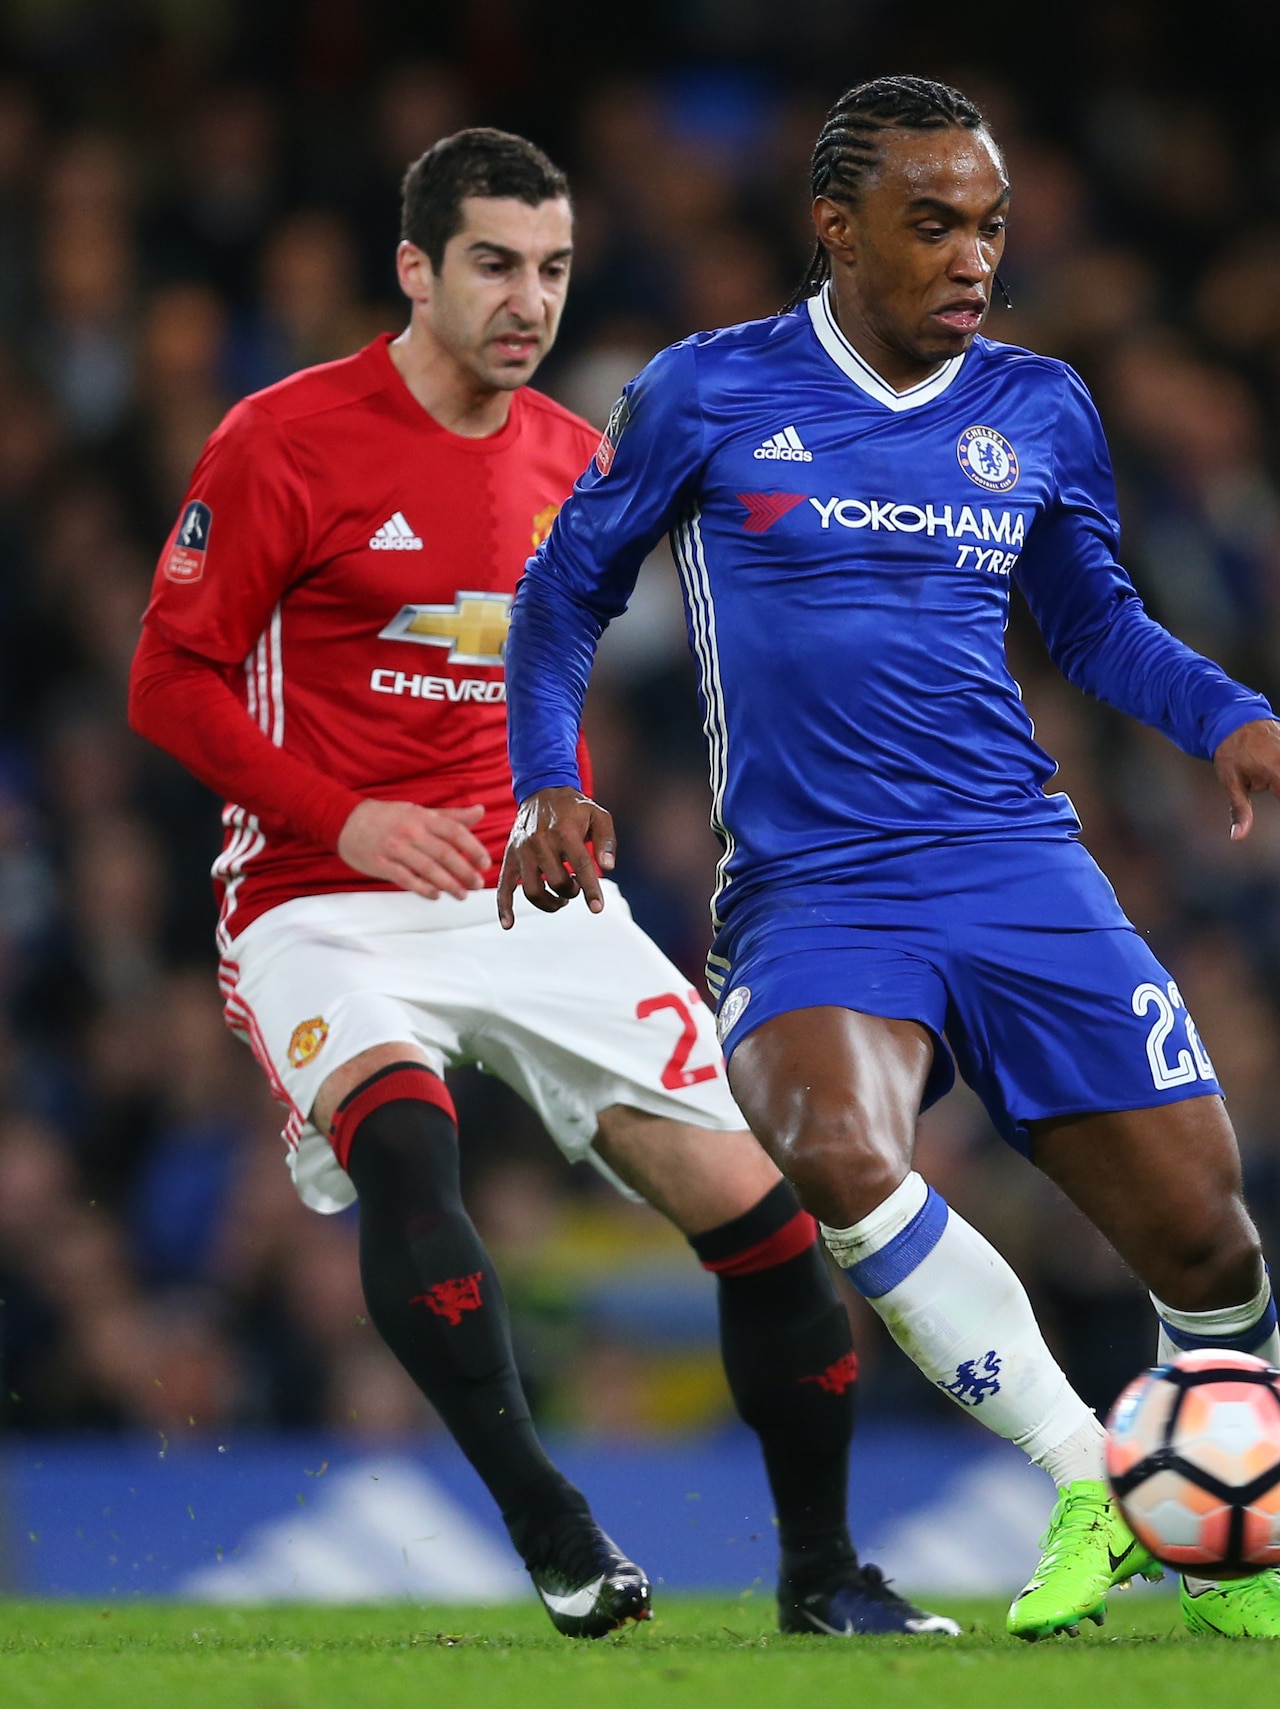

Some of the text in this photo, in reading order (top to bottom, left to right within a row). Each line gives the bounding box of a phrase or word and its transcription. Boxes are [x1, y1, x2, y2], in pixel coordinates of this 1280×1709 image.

[965, 428, 1005, 447] CHELSEA
[753, 447, 813, 462] adidas
[809, 497, 1025, 548] YOKOHAMA
[369, 536, 424, 551] adidas
[636, 989, 728, 1091] 2
